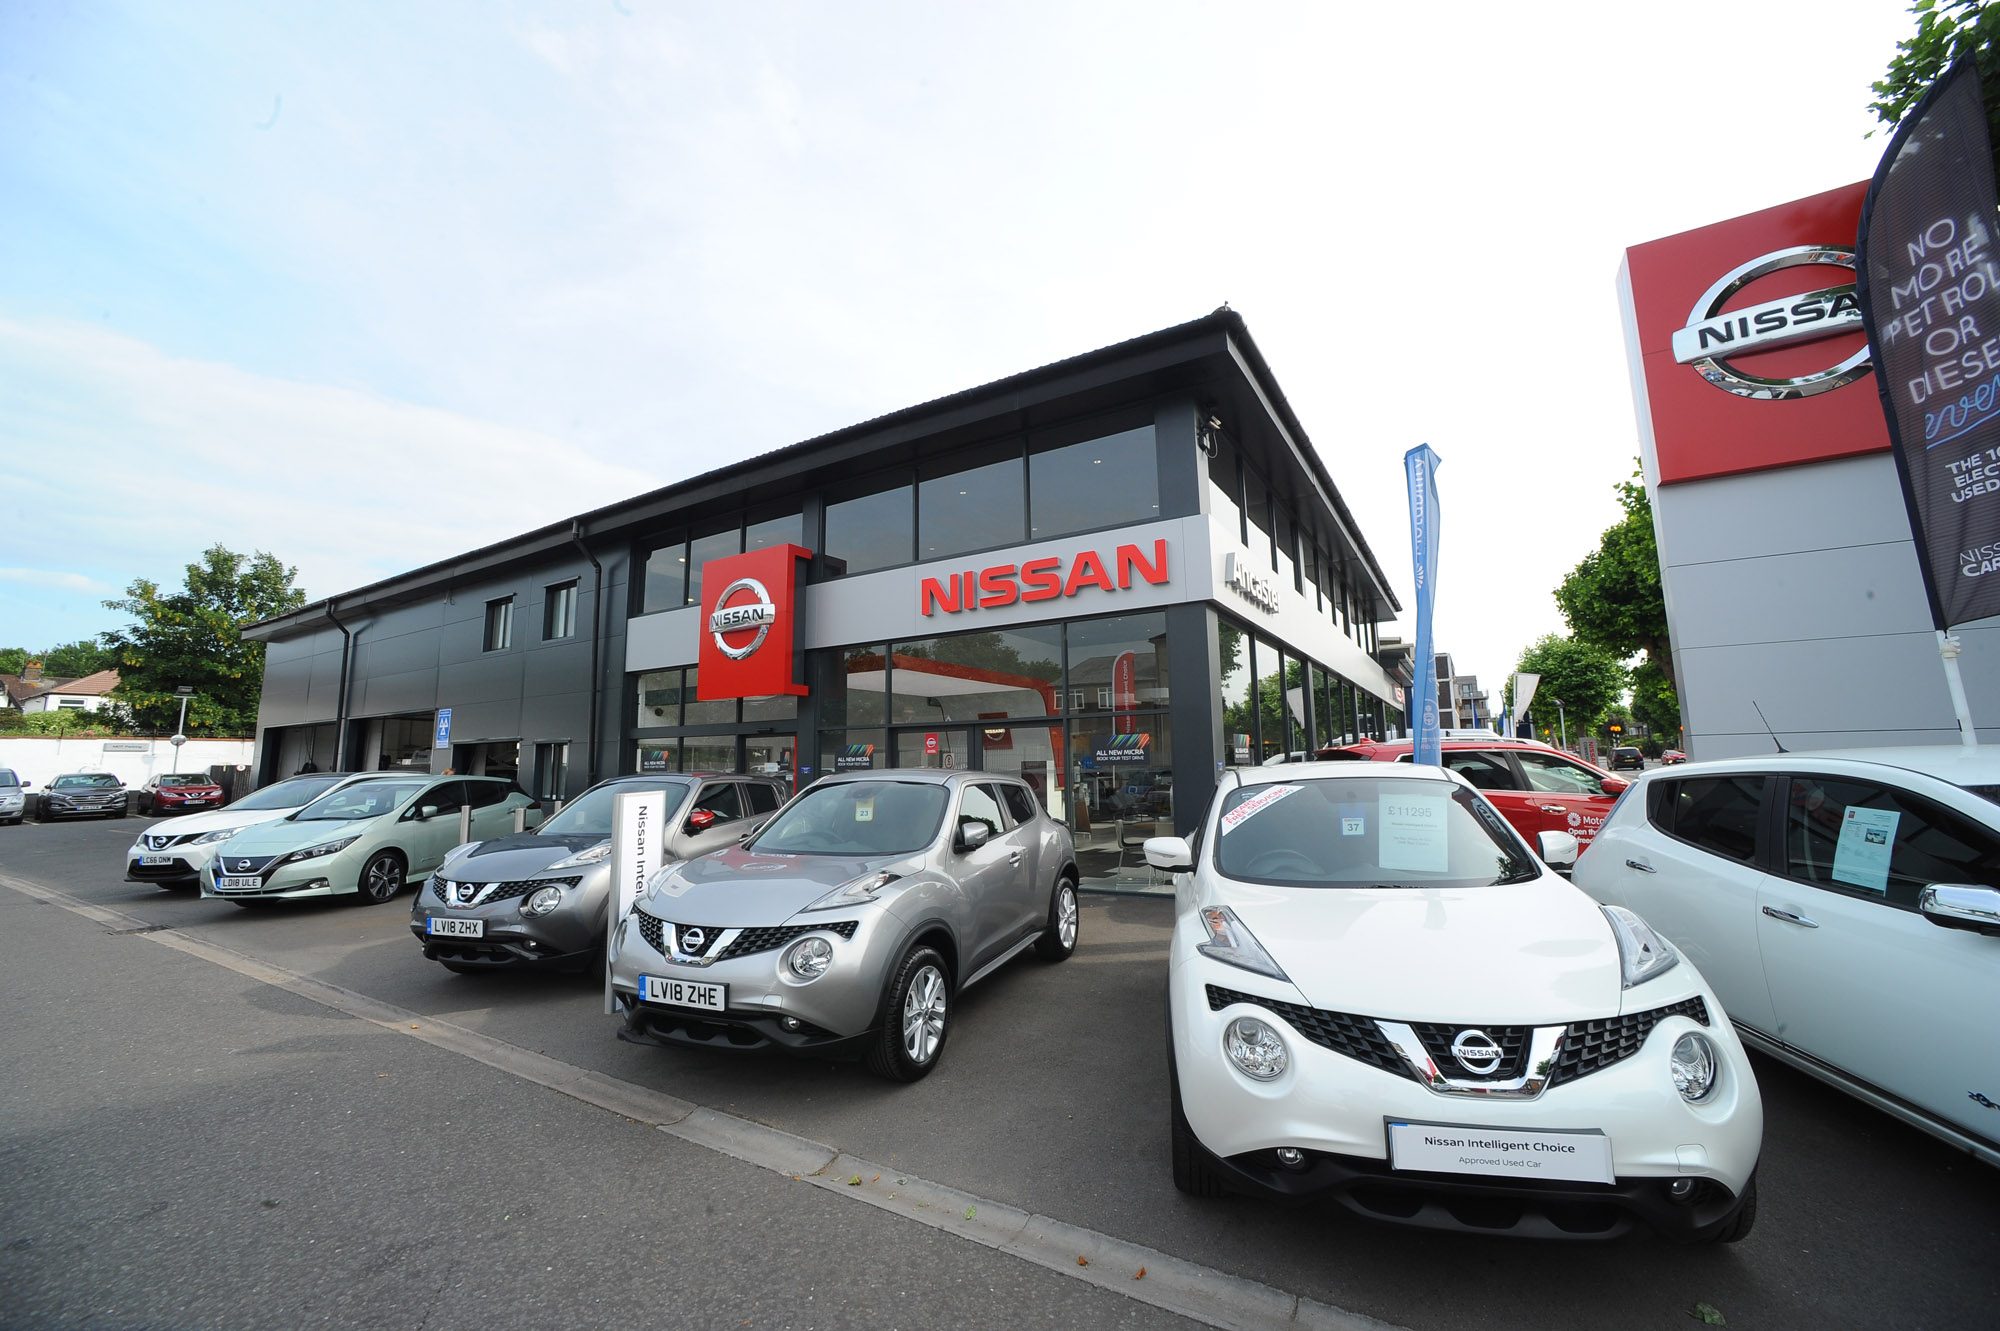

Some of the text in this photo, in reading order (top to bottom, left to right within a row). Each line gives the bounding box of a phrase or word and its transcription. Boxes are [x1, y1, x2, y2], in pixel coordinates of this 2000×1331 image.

[1907, 219, 1955, 266] NO
[1891, 233, 1984, 309] MORE
[1698, 291, 1861, 349] NISSA
[1926, 315, 1980, 355] OR
[1909, 335, 2000, 404] DIESE
[1945, 453, 1982, 474] THE
[1954, 462, 2000, 488] ELEC
[1951, 478, 2000, 502] USED
[921, 538, 1170, 617] NISSAN
[711, 607, 765, 627] NISSAN
[1347, 824, 1360, 832] 37
[1568, 828, 1587, 836] Open
[635, 805, 648, 897] Nissan Intel
[241, 878, 258, 887] ULE
[434, 921, 478, 934] LV18 ZHX
[651, 980, 717, 1006] LV18 ZHE
[1458, 1048, 1500, 1057] NISSAN
[1424, 1136, 1576, 1153] Nissan Intelligent Choice
[1458, 1156, 1542, 1168] Approved Used Car
